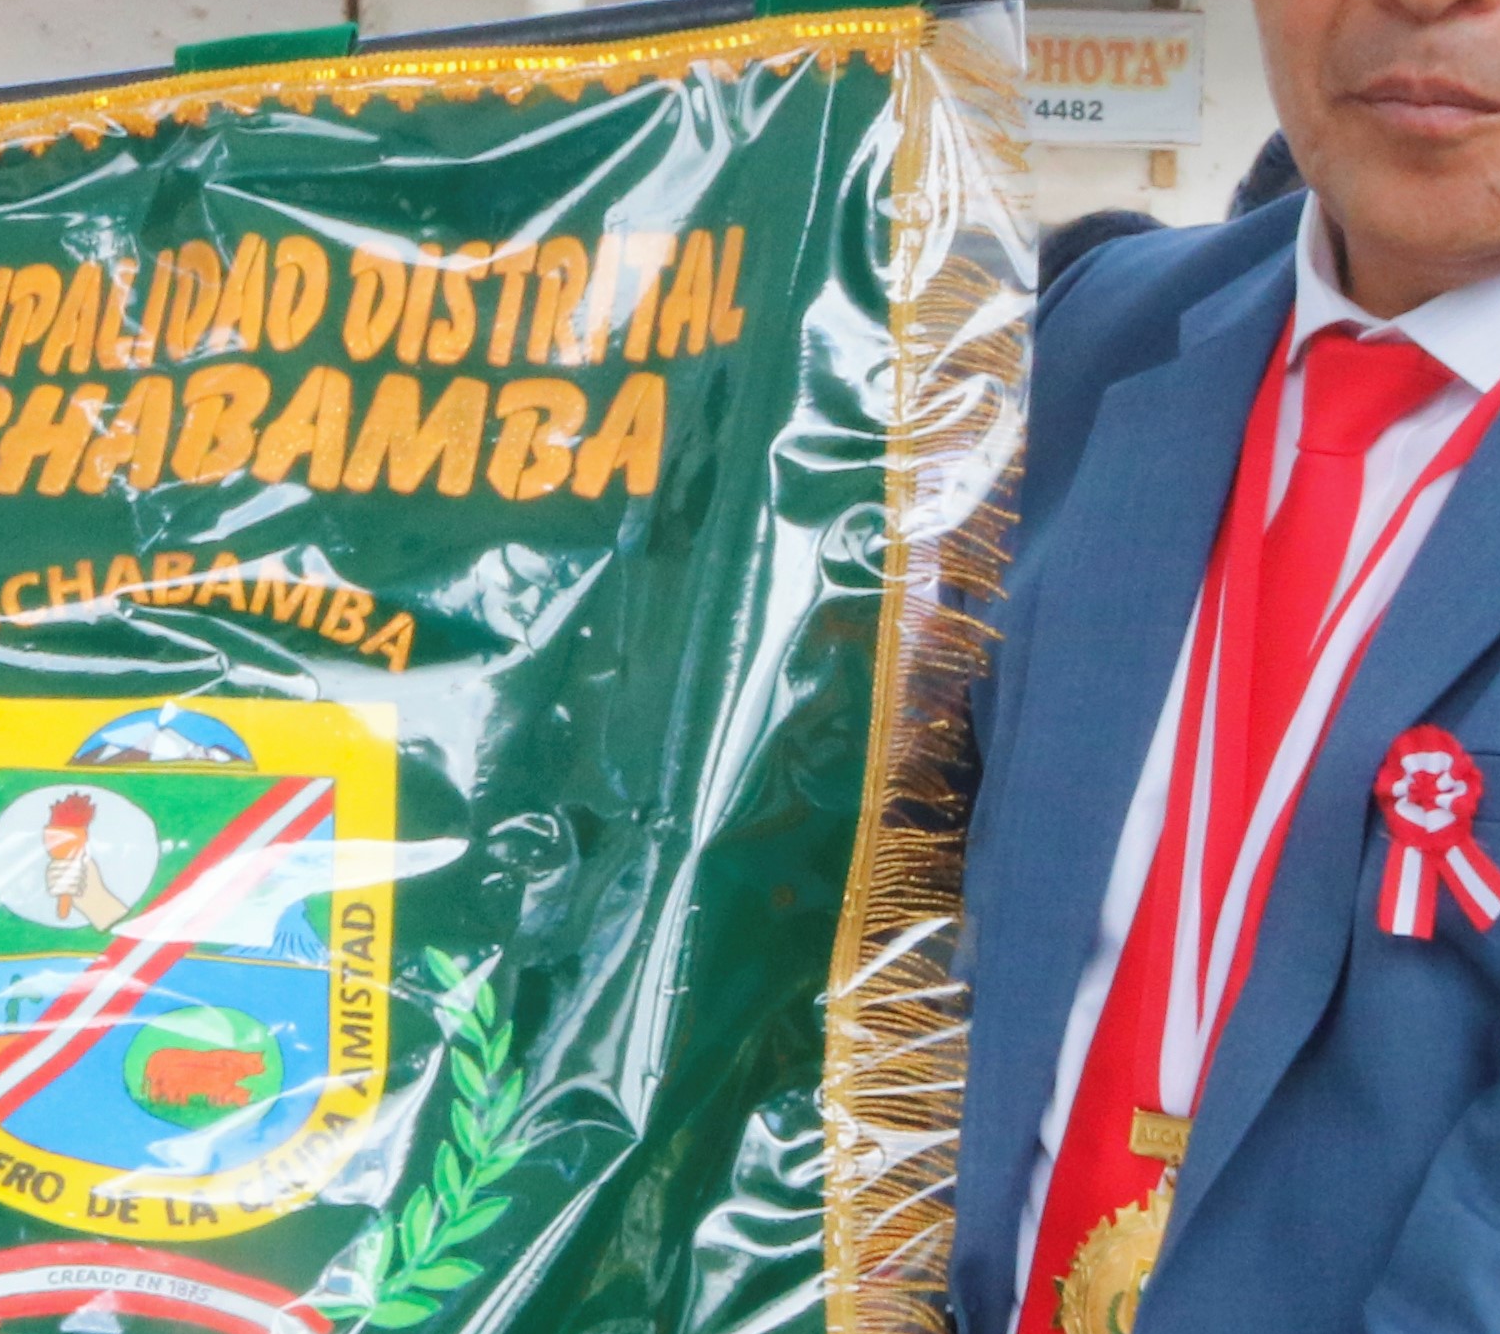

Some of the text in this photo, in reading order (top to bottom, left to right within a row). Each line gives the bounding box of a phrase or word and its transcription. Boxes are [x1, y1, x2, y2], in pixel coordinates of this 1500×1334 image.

[342, 225, 745, 366] DISTRITAL
[87, 1189, 139, 1224] DE
[164, 1190, 218, 1227] LA
[340, 901, 377, 1097] AMISTAD
[47, 1269, 127, 1286] CREADO
[135, 1273, 163, 1291] EN
